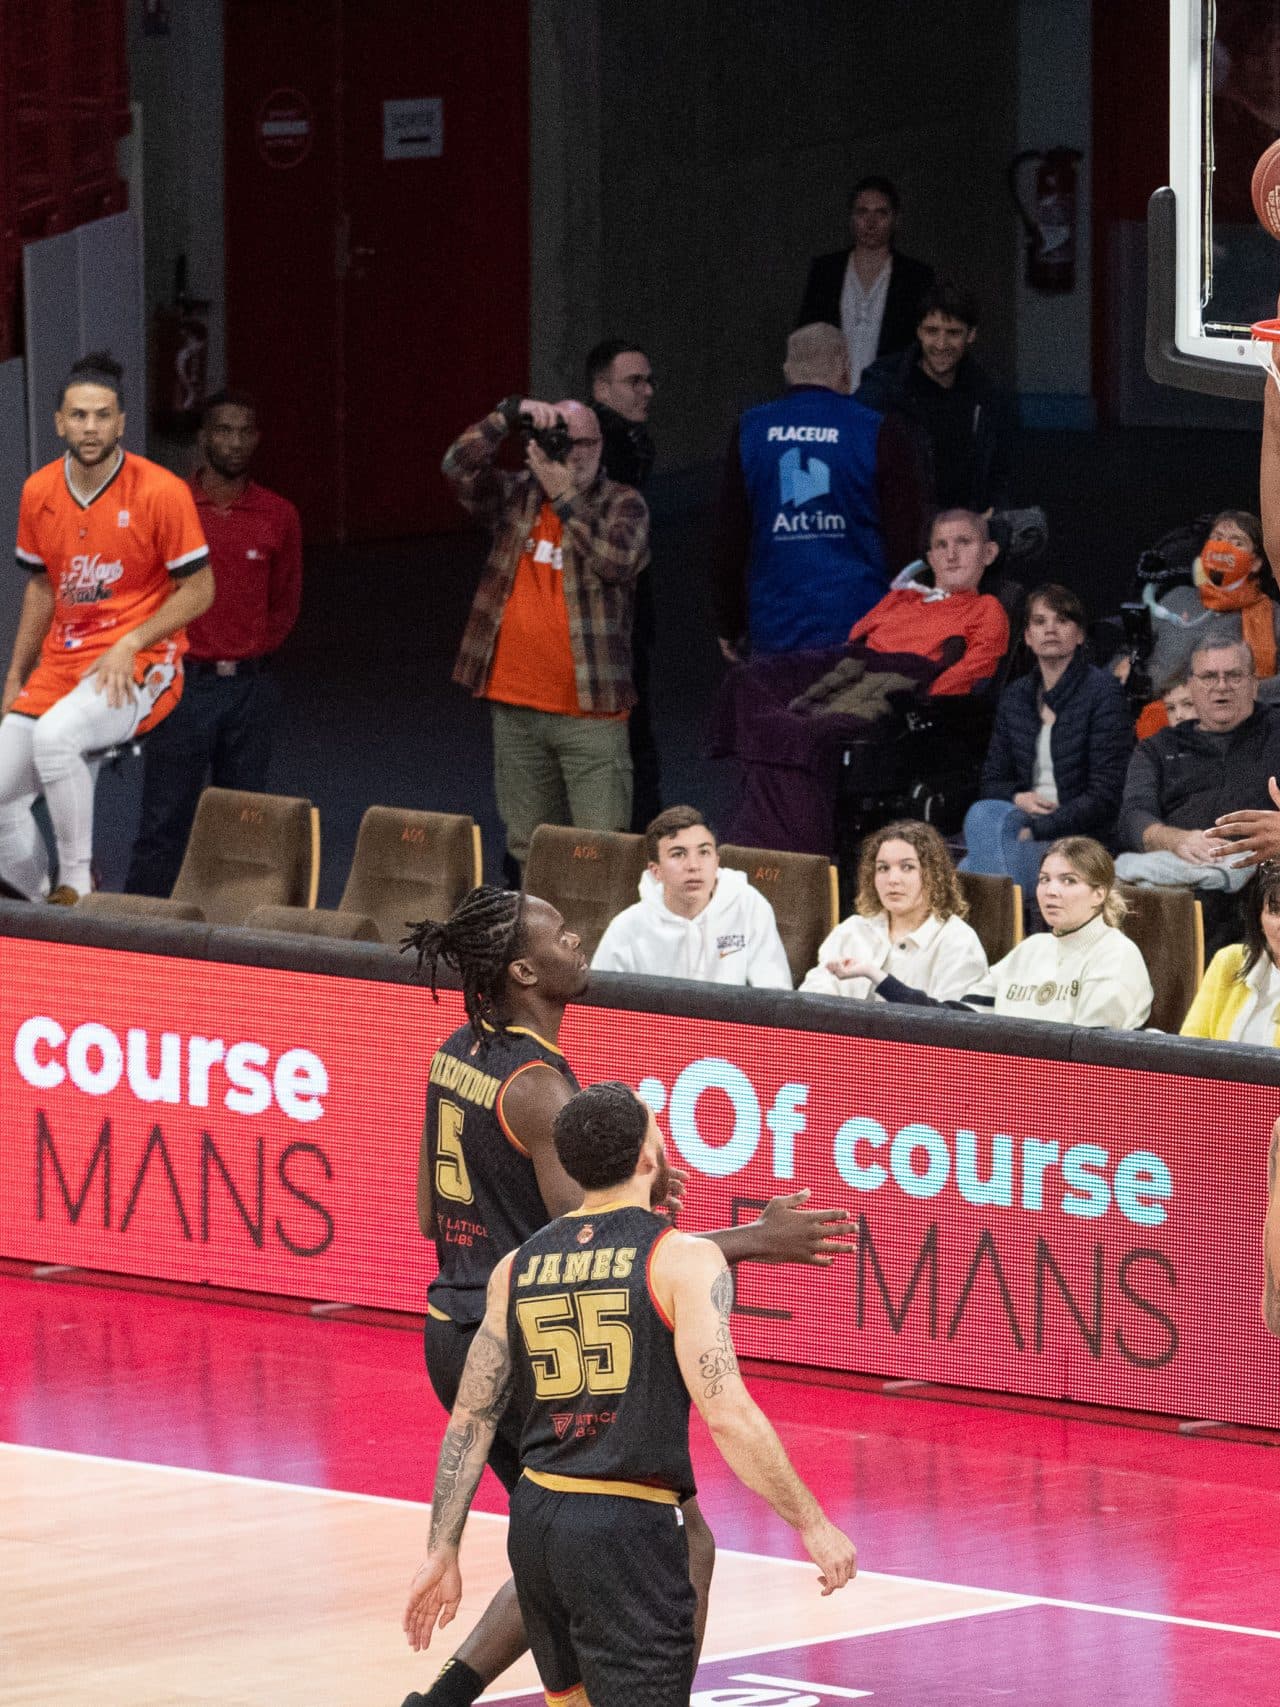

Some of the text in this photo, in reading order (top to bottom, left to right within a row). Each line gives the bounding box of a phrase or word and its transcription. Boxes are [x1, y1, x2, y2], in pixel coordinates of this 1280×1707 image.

[767, 426, 839, 443] PLACEUR
[772, 510, 847, 533] Art'im
[14, 1016, 329, 1122] course
[36, 1109, 334, 1258] MANS
[435, 1097, 475, 1206] 5
[833, 1116, 1174, 1226] course
[517, 1248, 637, 1287] JAMES
[857, 1213, 1180, 1370] MANS
[516, 1288, 634, 1400] 55
